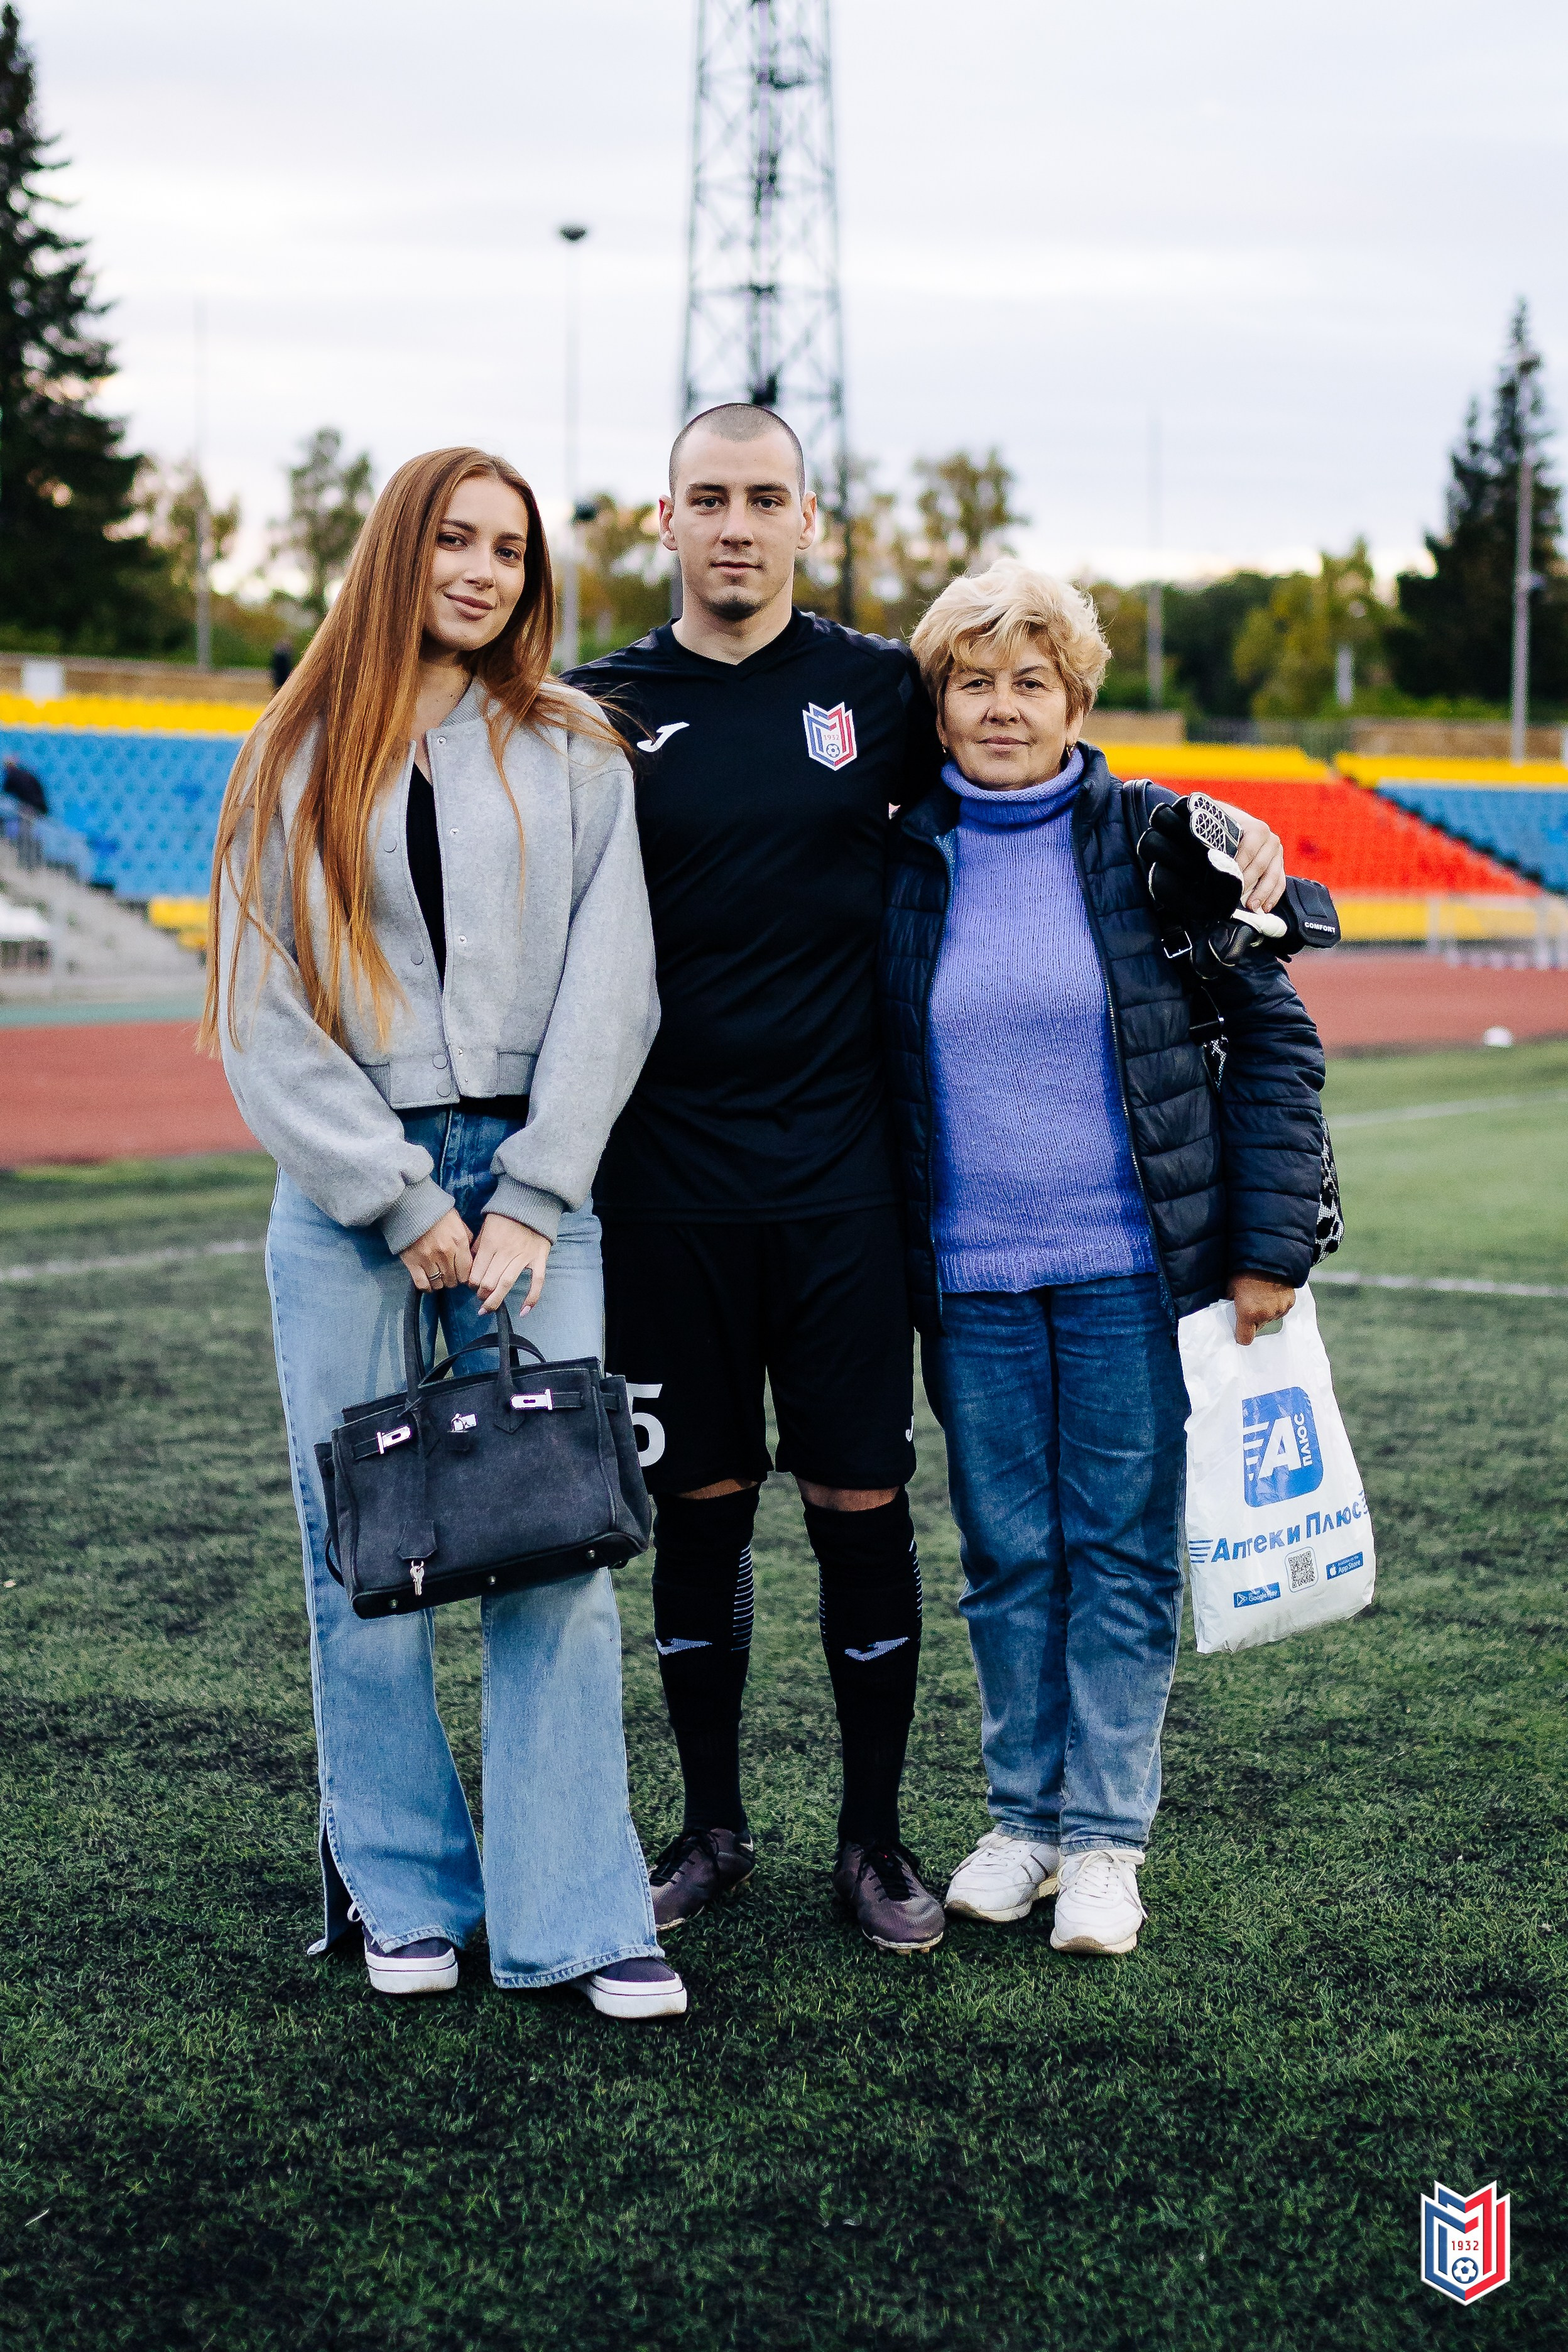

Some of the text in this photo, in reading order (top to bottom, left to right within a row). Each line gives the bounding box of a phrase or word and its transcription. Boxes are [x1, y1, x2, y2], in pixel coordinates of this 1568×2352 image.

[1304, 922, 1336, 934] COMFORT
[1211, 1501, 1362, 1563] Аптеки Плюс
